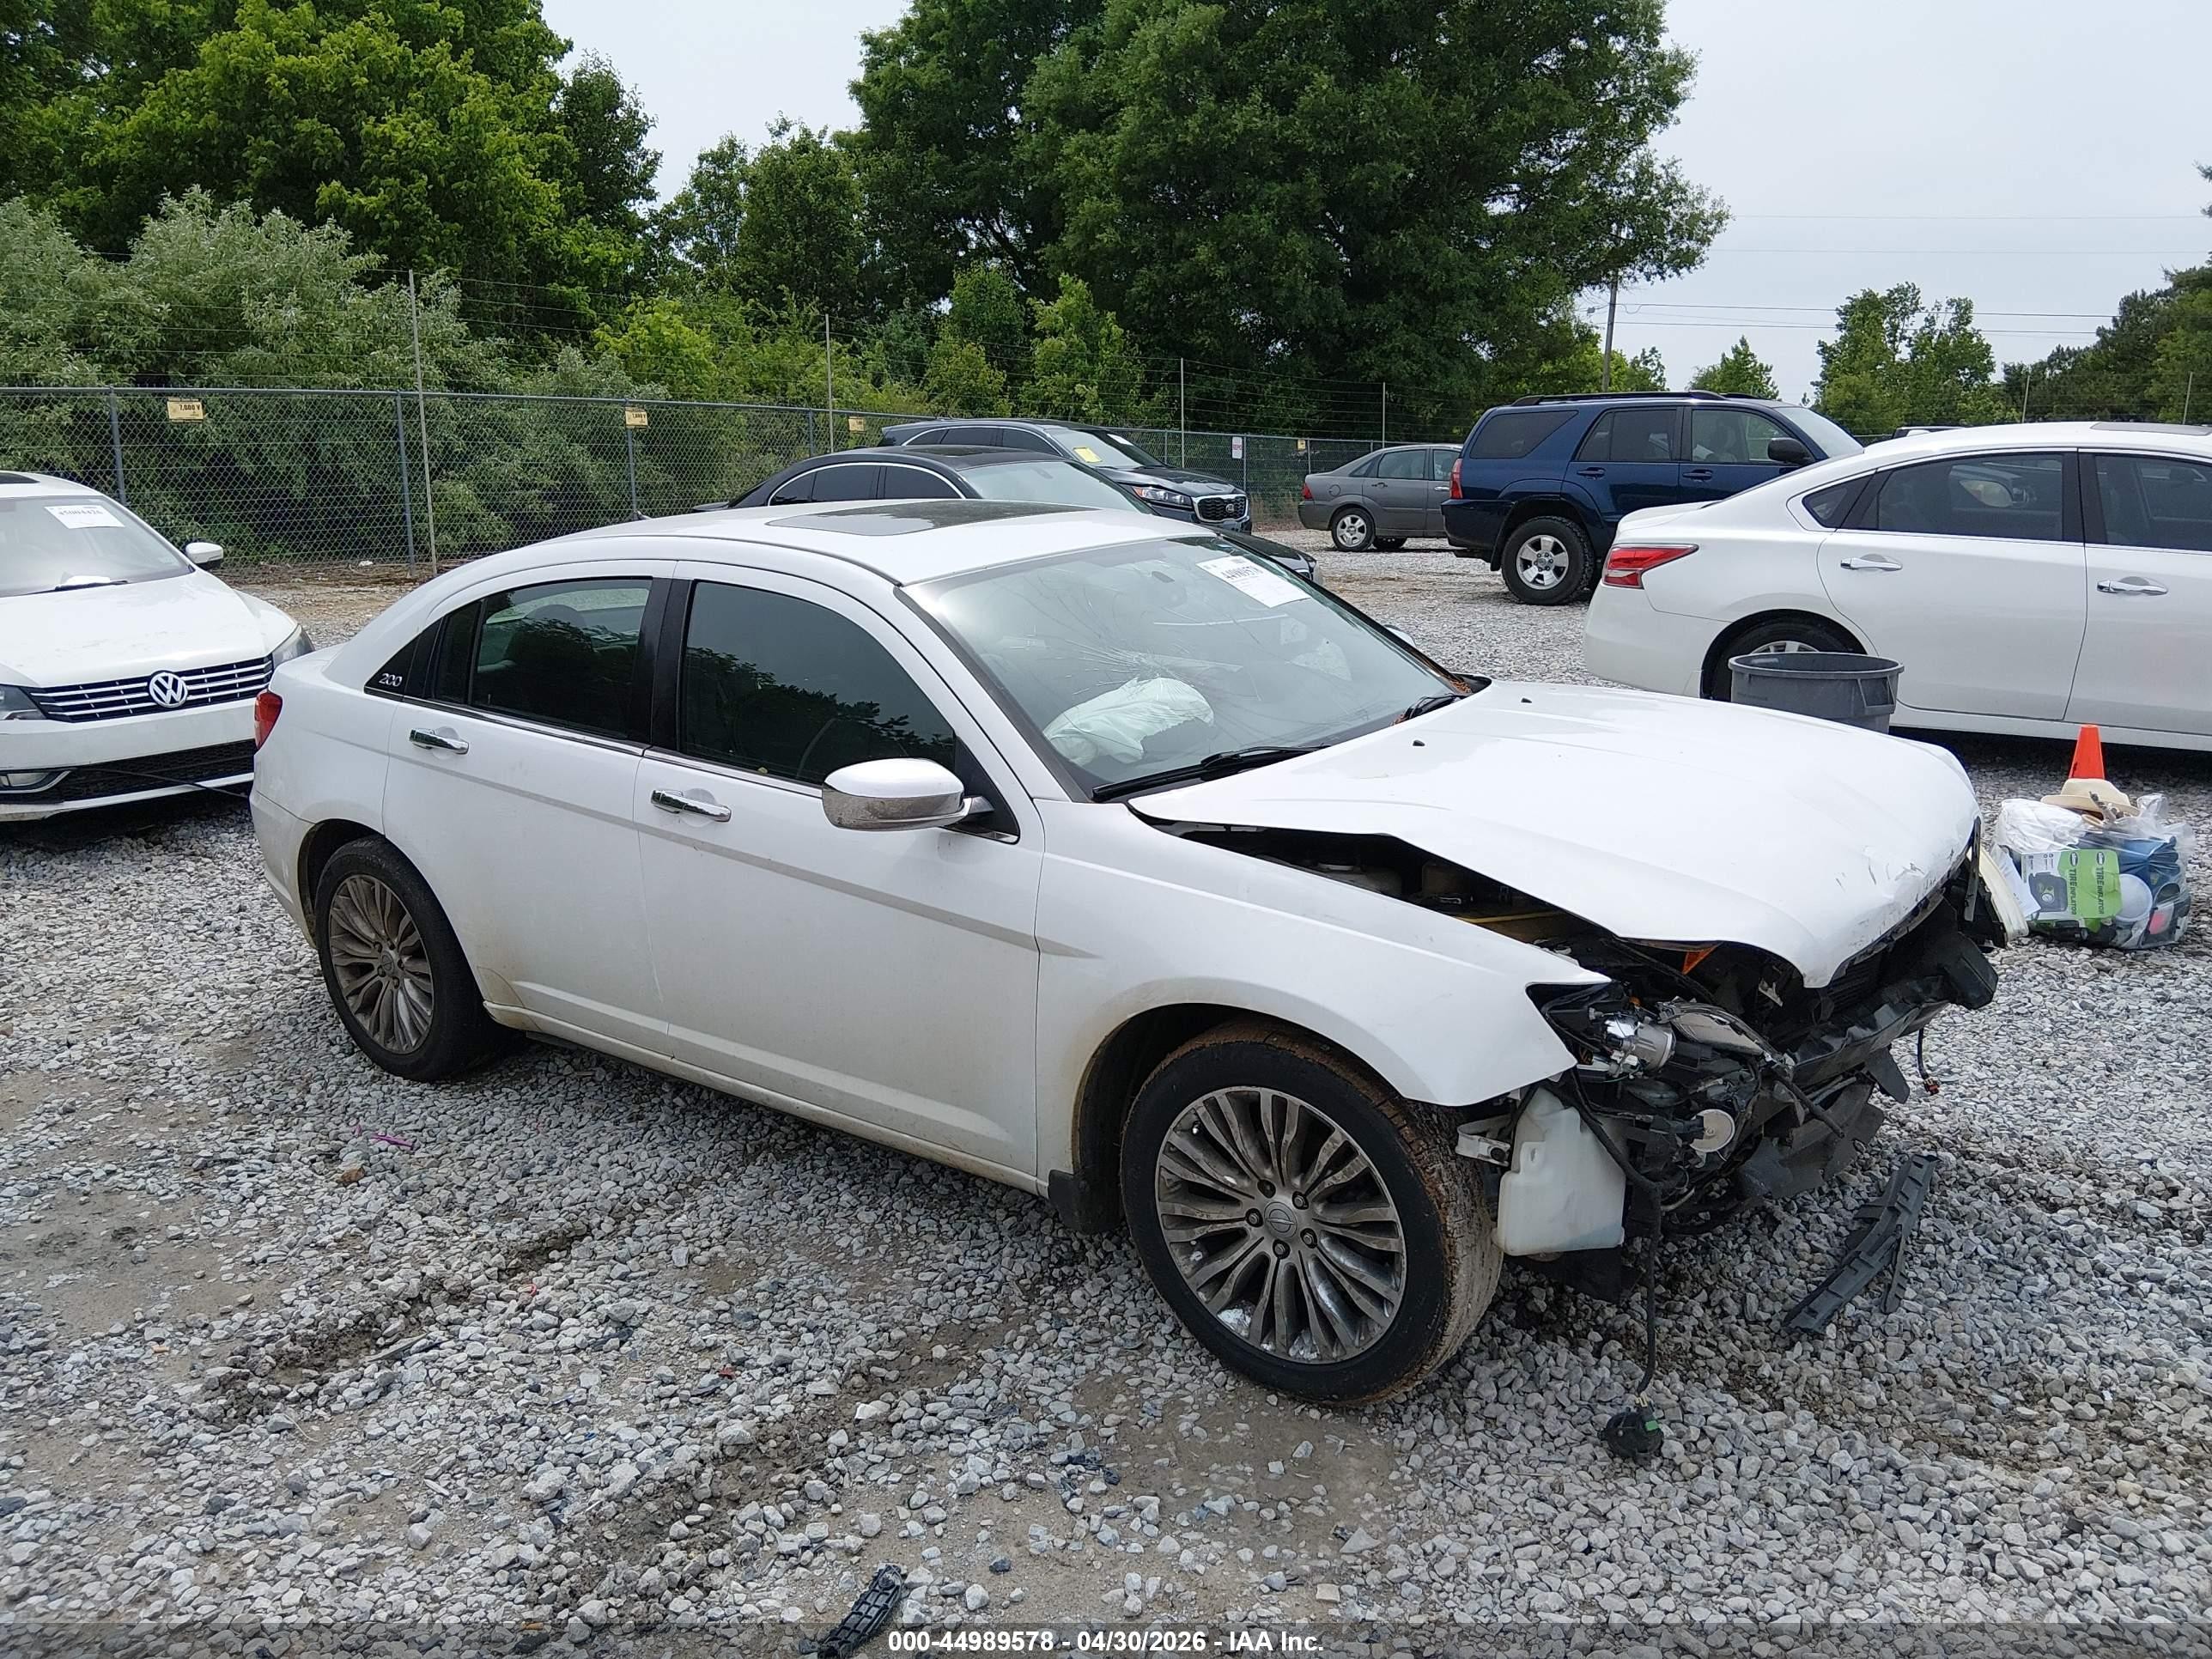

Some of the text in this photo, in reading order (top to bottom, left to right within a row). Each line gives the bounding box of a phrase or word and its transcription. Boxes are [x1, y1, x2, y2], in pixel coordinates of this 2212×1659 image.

[379, 672, 403, 687] 200
[149, 672, 187, 708] VW
[2096, 866, 2105, 885] TIRE
